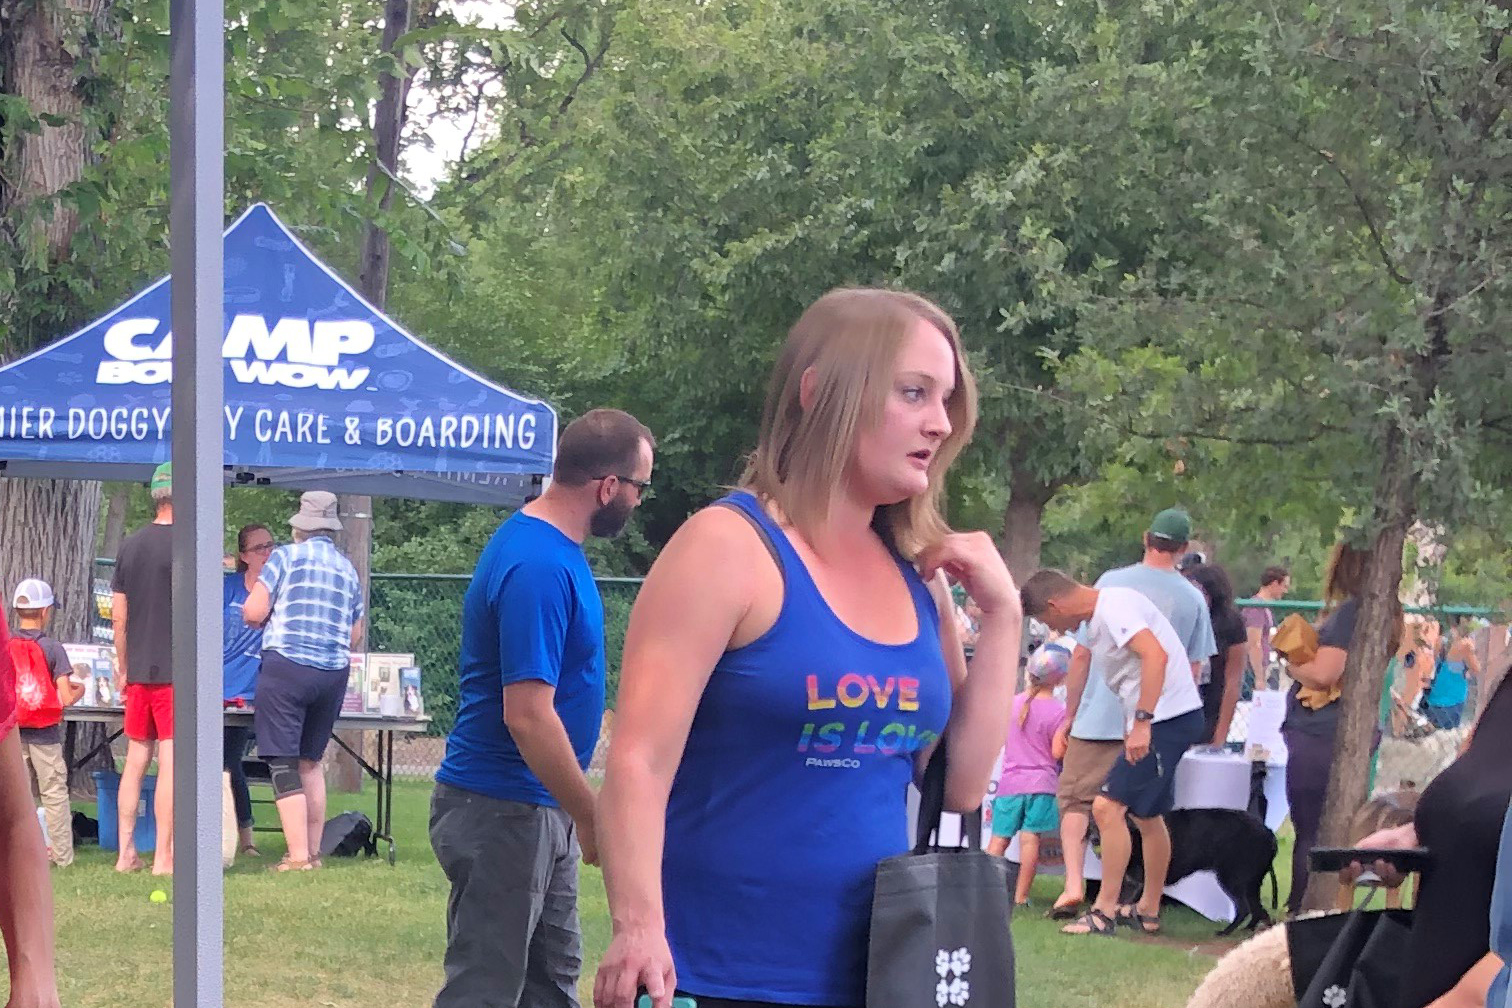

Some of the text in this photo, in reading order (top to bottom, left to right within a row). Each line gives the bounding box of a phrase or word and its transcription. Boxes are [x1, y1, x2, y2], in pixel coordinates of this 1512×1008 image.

[103, 315, 375, 366] CMP
[230, 361, 370, 390] WOW
[68, 406, 172, 440] DOGGY
[254, 409, 331, 444] CARE
[344, 415, 362, 446] &
[375, 413, 536, 450] BOARDING
[806, 673, 920, 712] LOVE
[797, 722, 846, 754] IS
